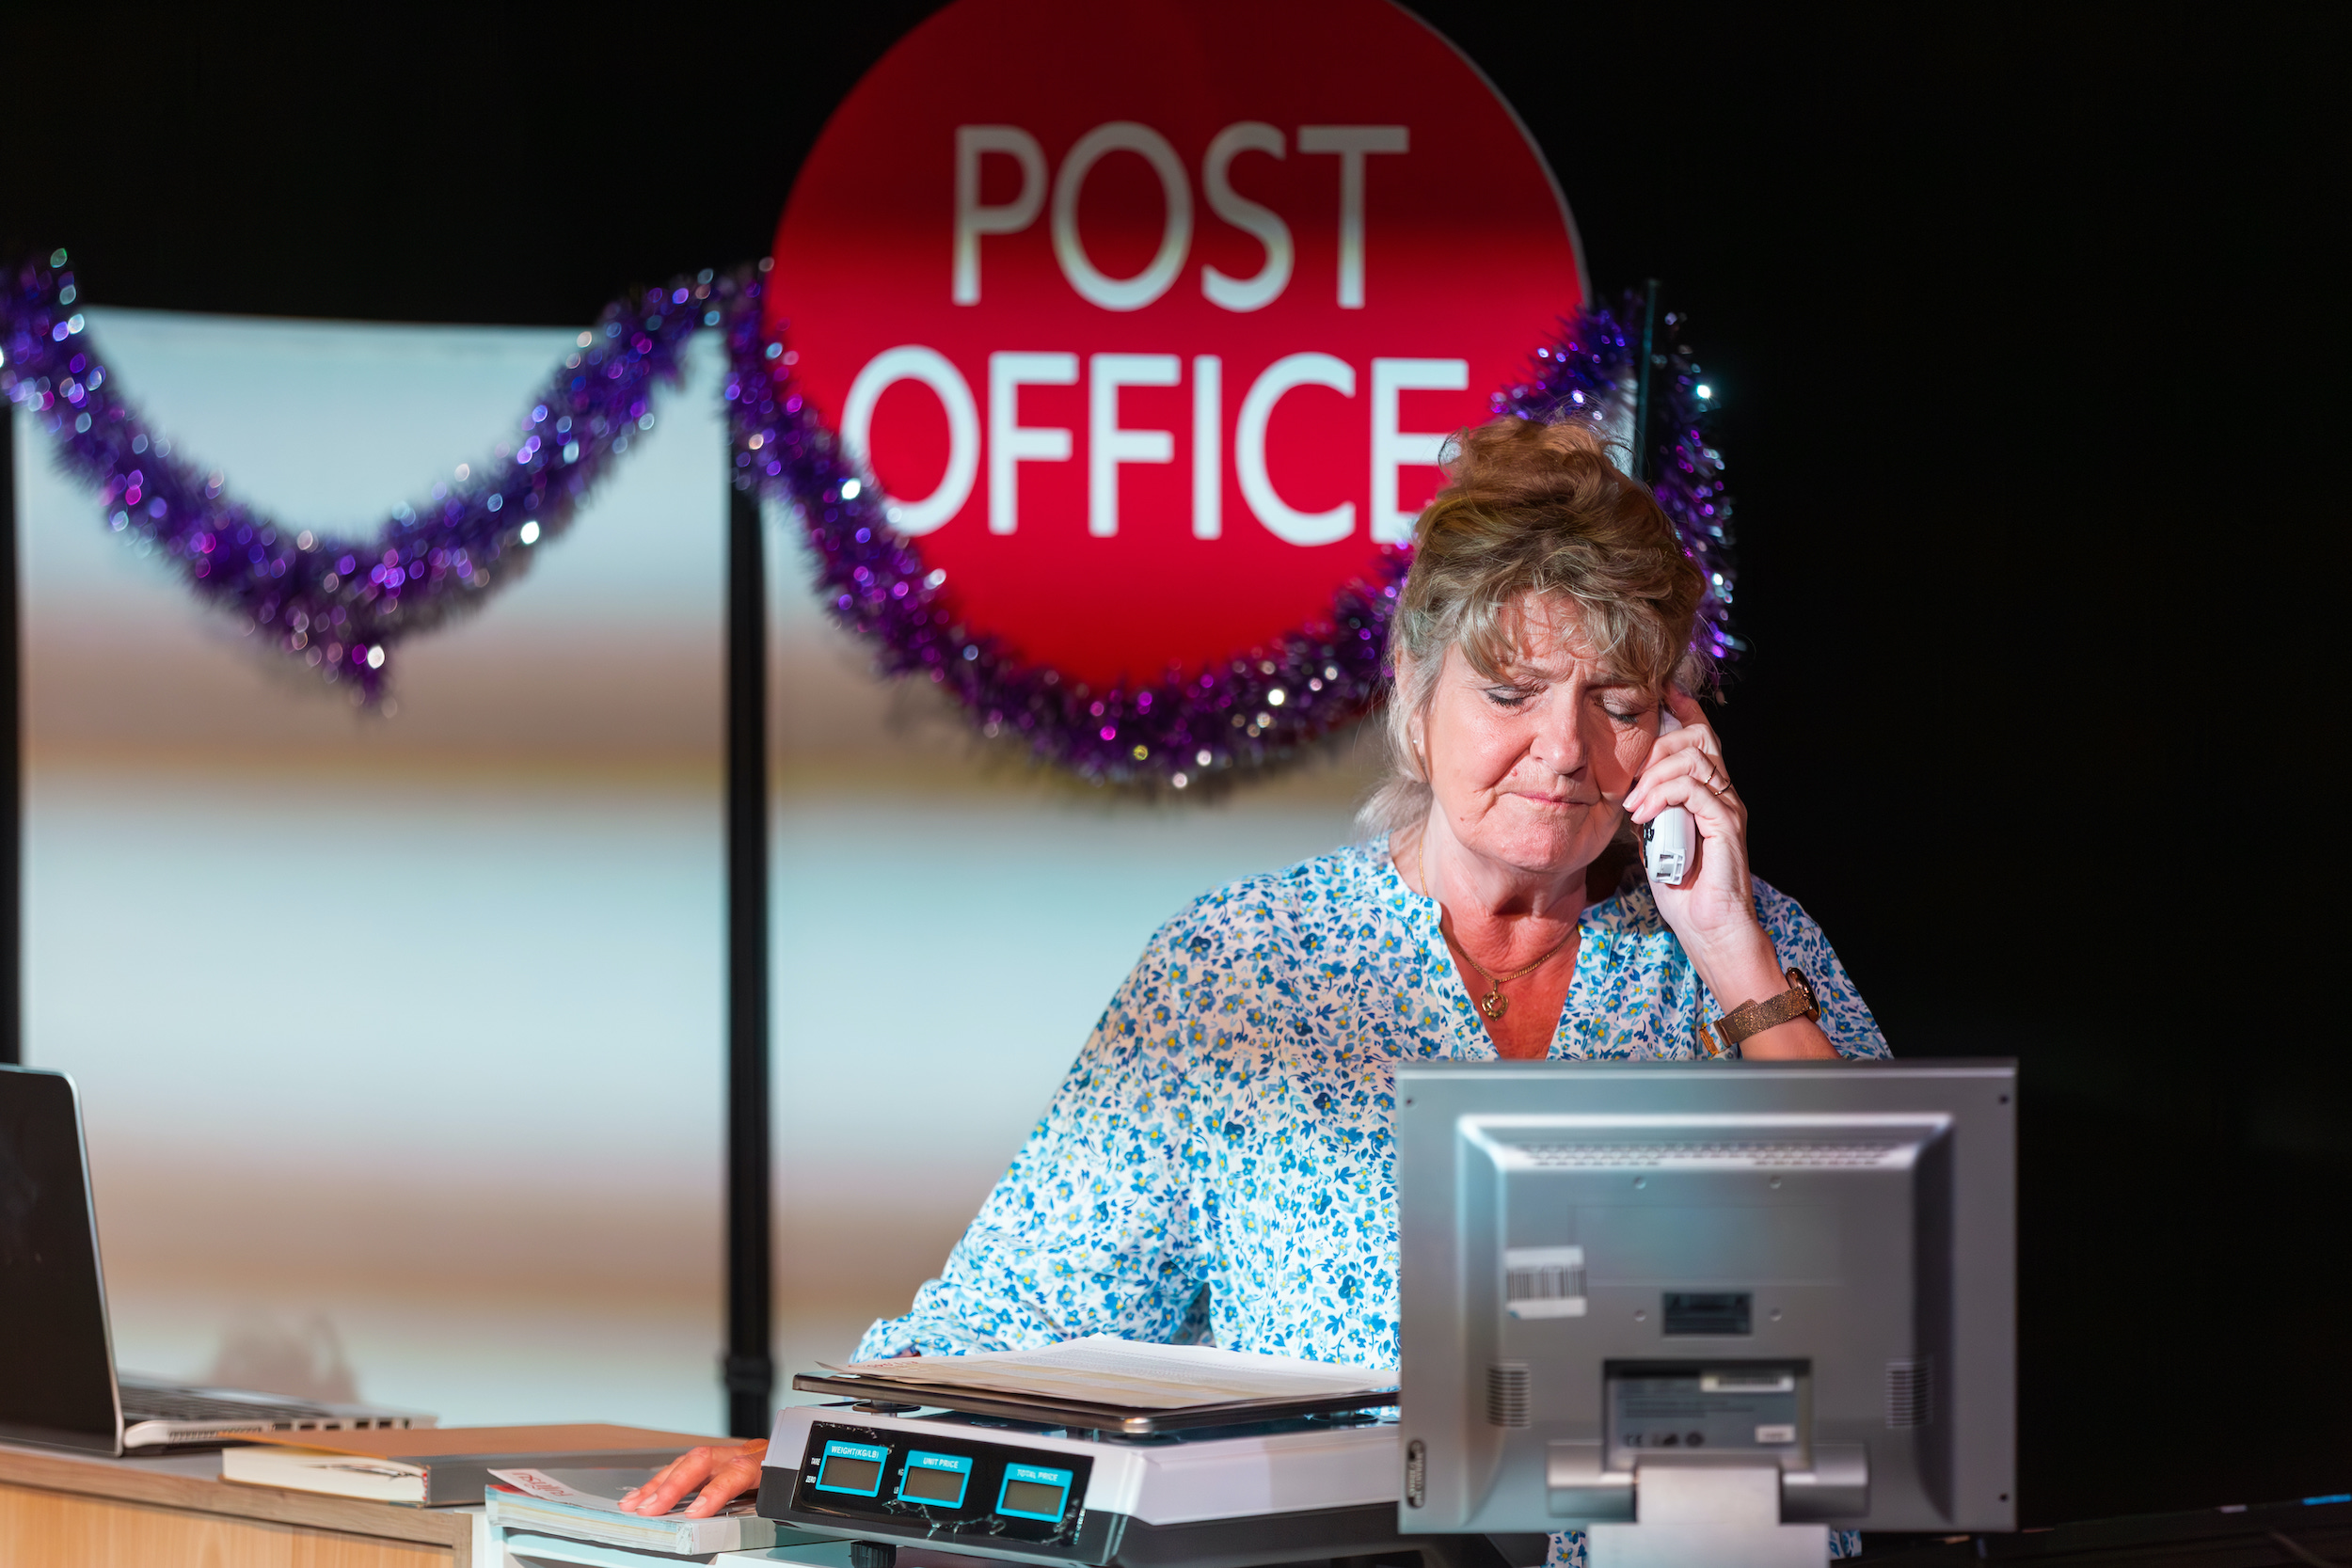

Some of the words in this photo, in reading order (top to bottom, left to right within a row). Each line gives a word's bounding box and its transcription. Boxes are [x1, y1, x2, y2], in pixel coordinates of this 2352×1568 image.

[952, 121, 1409, 312] POST
[840, 344, 1470, 546] OFFICE
[831, 1445, 880, 1459] WEIGHT(KG/LB)
[923, 1457, 939, 1466] UNIT
[939, 1459, 960, 1469] PRICE
[804, 1476, 817, 1484] ZERO
[1017, 1468, 1037, 1480] TOTAL
[1038, 1471, 1059, 1482] PRICE
